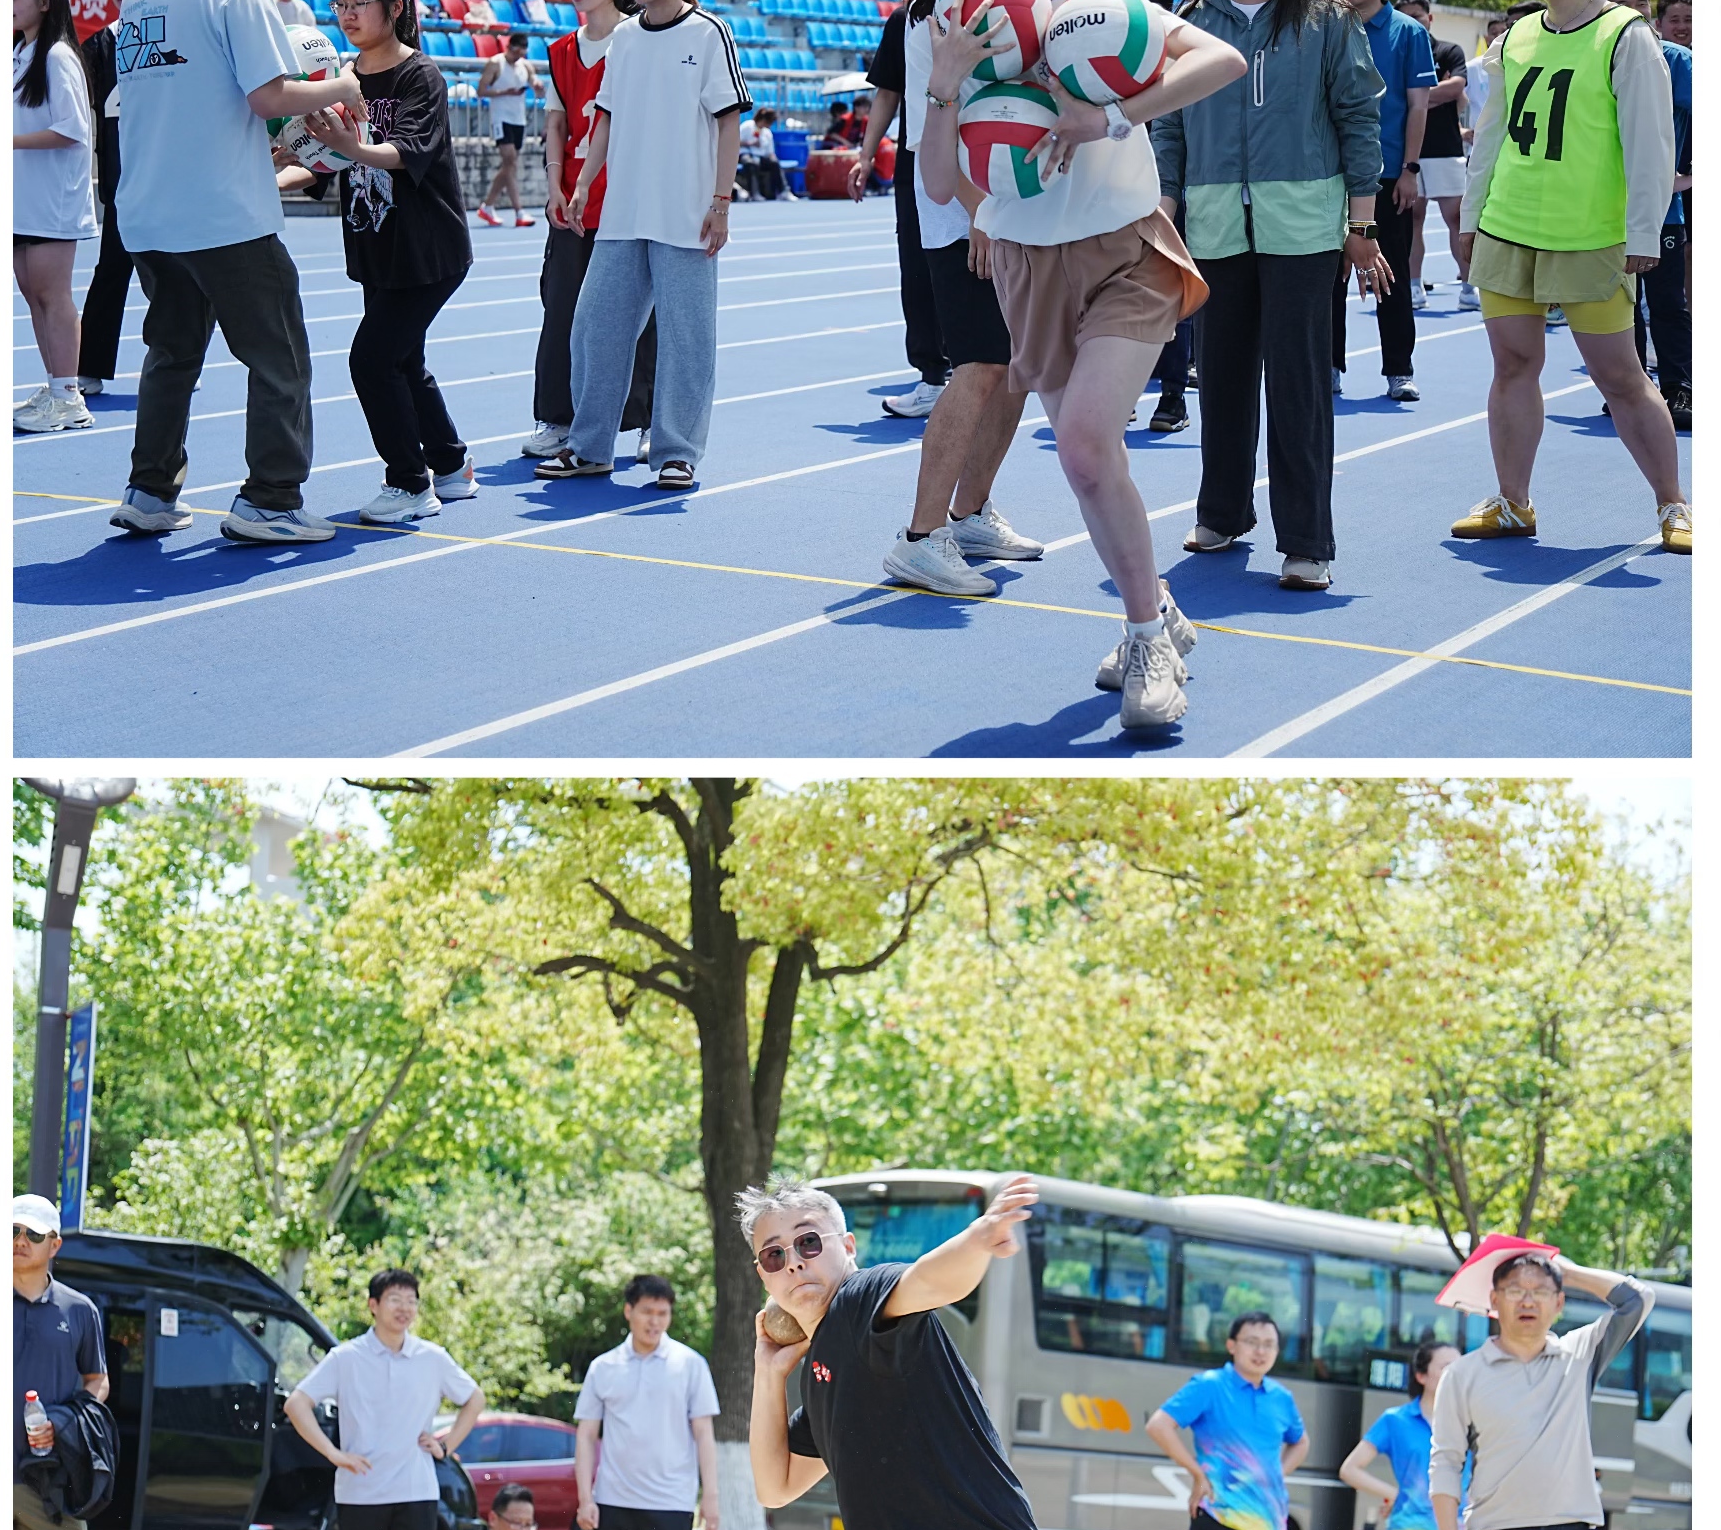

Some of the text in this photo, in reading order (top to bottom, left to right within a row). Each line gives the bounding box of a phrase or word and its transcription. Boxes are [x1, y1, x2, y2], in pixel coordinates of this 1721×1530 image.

[141, 5, 169, 17] EARTH
[1049, 12, 1106, 41] molten
[1507, 66, 1575, 162] 41
